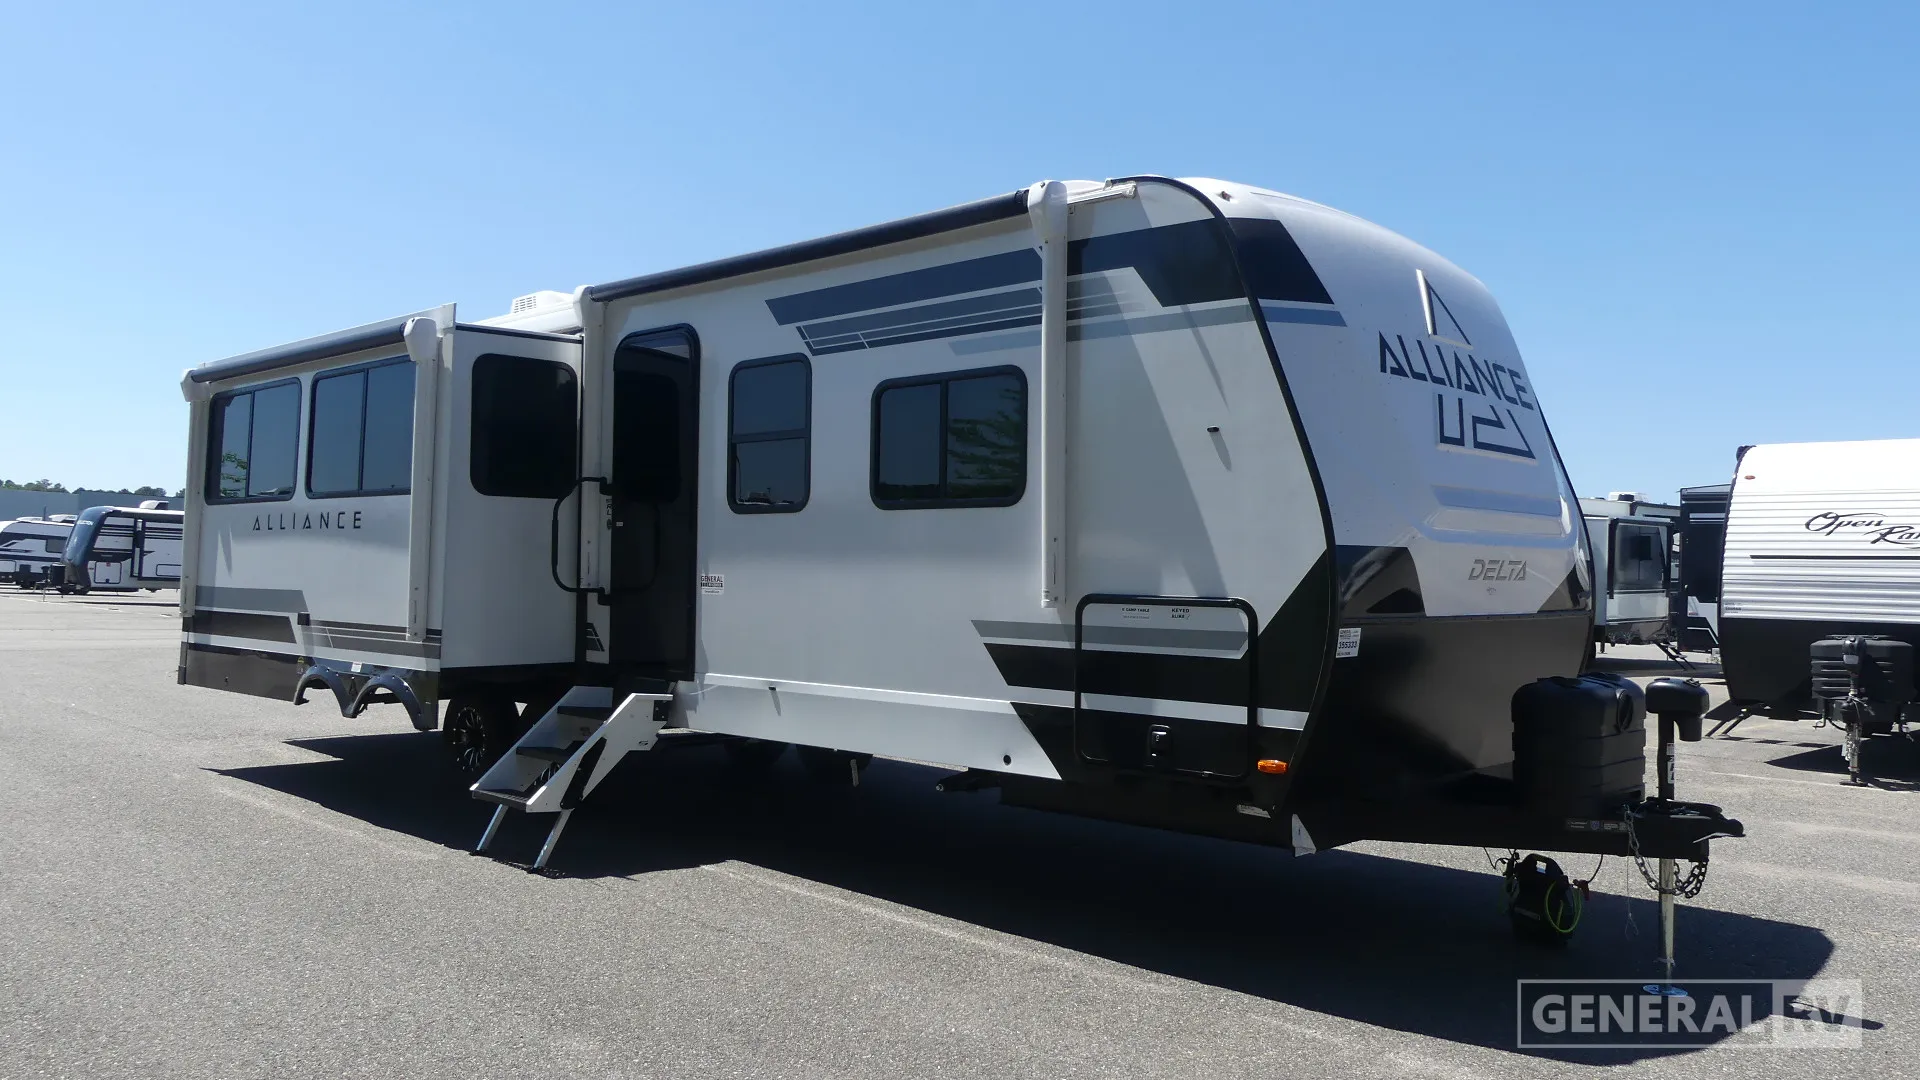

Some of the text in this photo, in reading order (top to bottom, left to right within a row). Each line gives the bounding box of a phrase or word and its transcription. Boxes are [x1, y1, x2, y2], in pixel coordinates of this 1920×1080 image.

[1378, 331, 1534, 410] ALLIANCE
[252, 511, 362, 531] ALLIANCE
[1805, 511, 1887, 537] Open
[1468, 559, 1527, 581] DELTA
